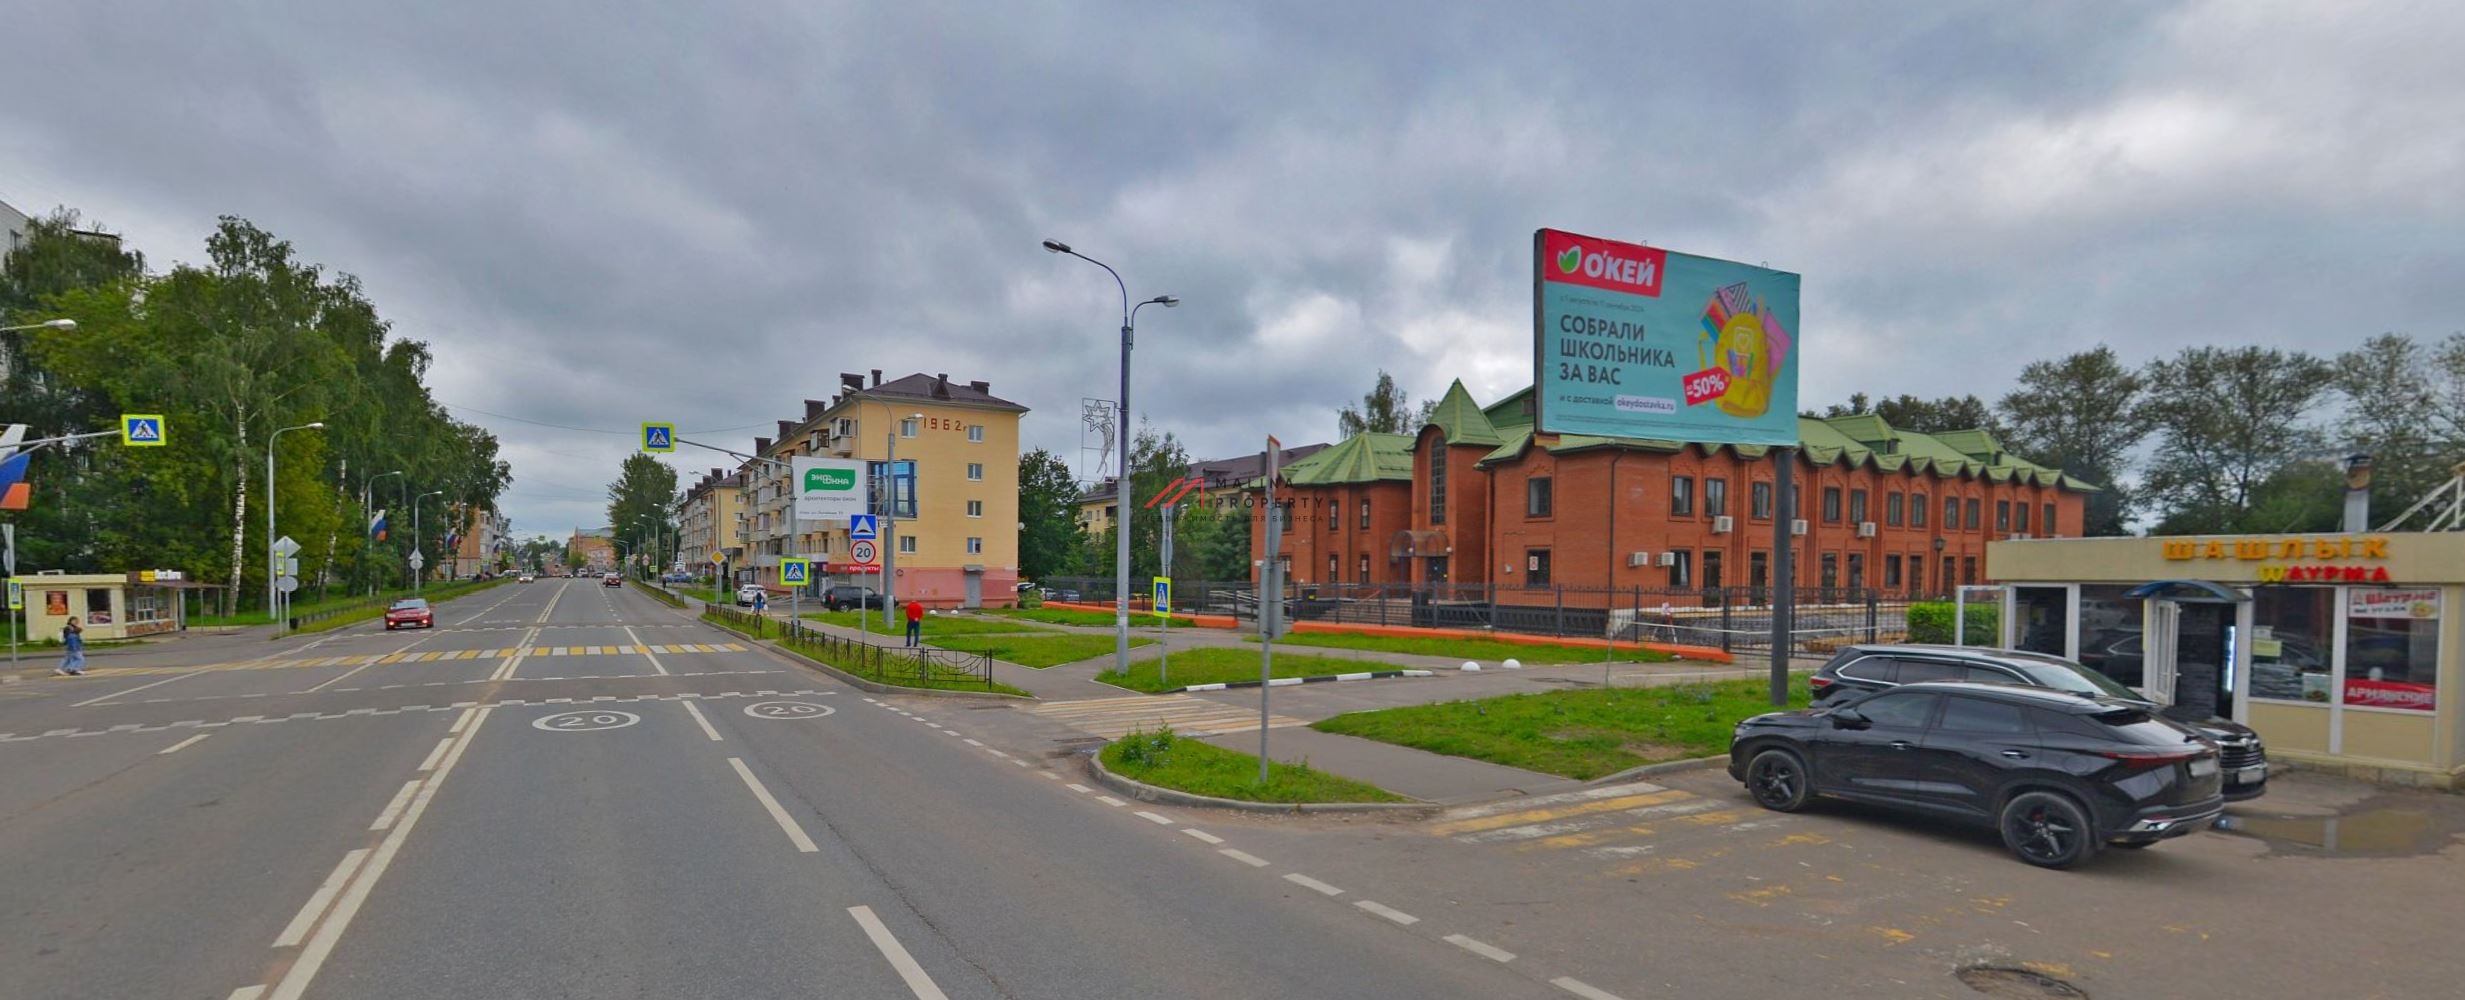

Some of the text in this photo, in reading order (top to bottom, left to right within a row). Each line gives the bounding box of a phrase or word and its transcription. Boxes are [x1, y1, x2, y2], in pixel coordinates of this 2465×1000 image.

[1560, 314, 1645, 341] СОБРАЛИ
[1560, 338, 1676, 368] ШКОЛЬНИКА
[1559, 362, 1622, 385] ЗА ВАС
[856, 547, 871, 558] 20
[2162, 538, 2389, 561] ШАШЛЫК
[557, 714, 618, 727] 20
[763, 705, 817, 715] 20
